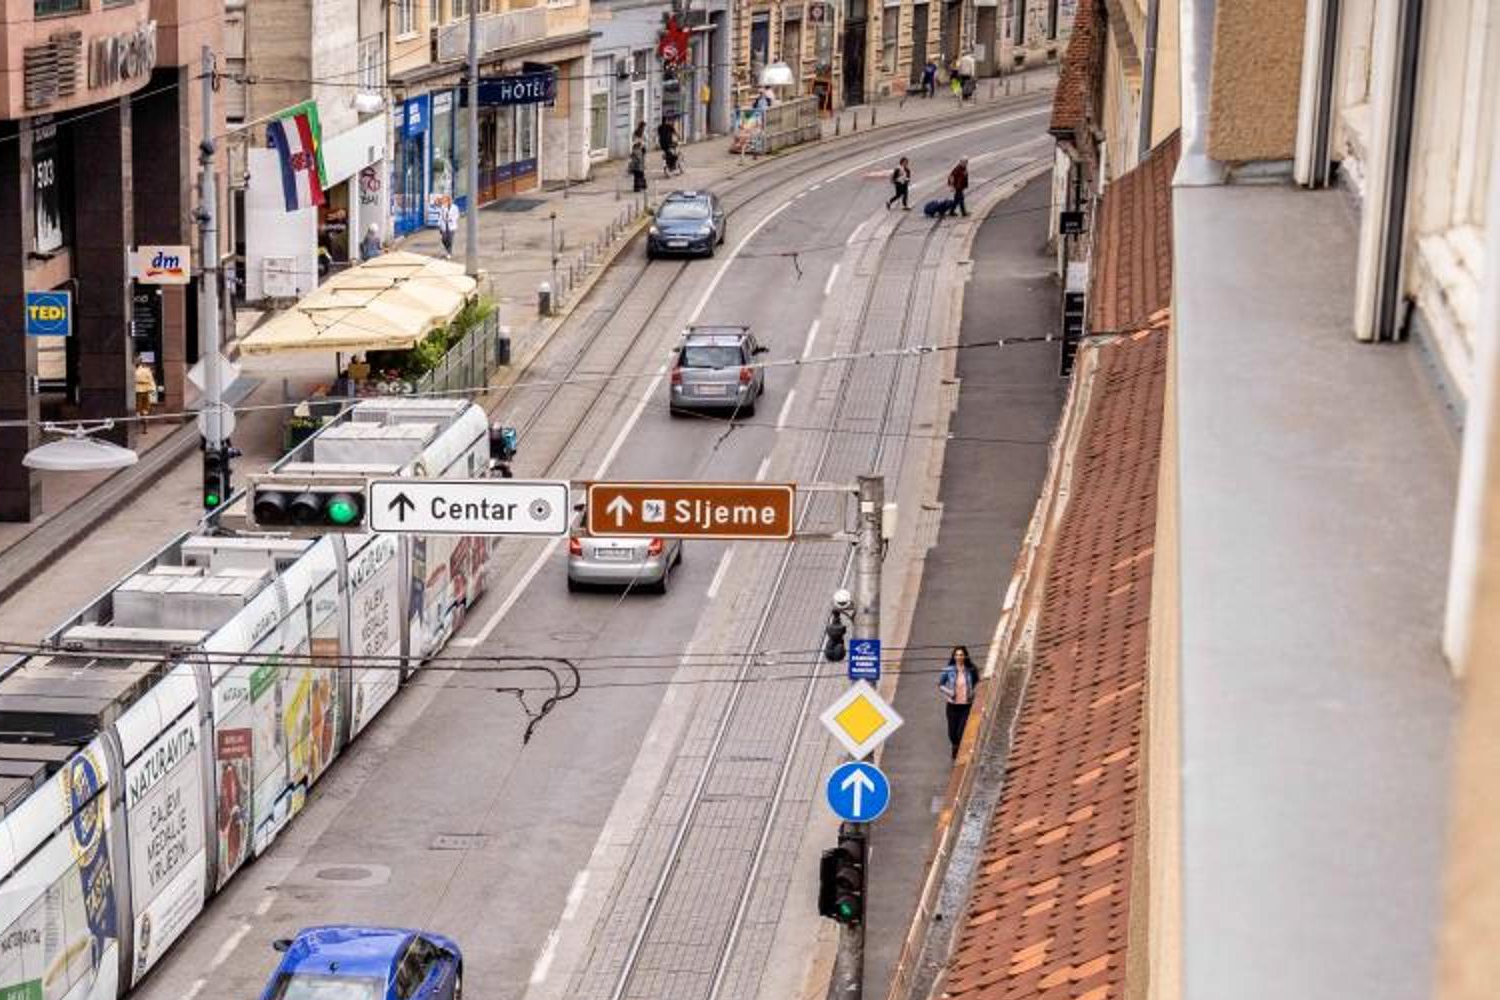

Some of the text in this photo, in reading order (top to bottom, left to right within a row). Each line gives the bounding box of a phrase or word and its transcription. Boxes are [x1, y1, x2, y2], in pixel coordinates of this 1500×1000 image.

[152, 251, 180, 269] dm
[430, 497, 518, 520] Centar
[674, 499, 777, 529] Sljeme
[129, 726, 197, 802] NATURAVITA
